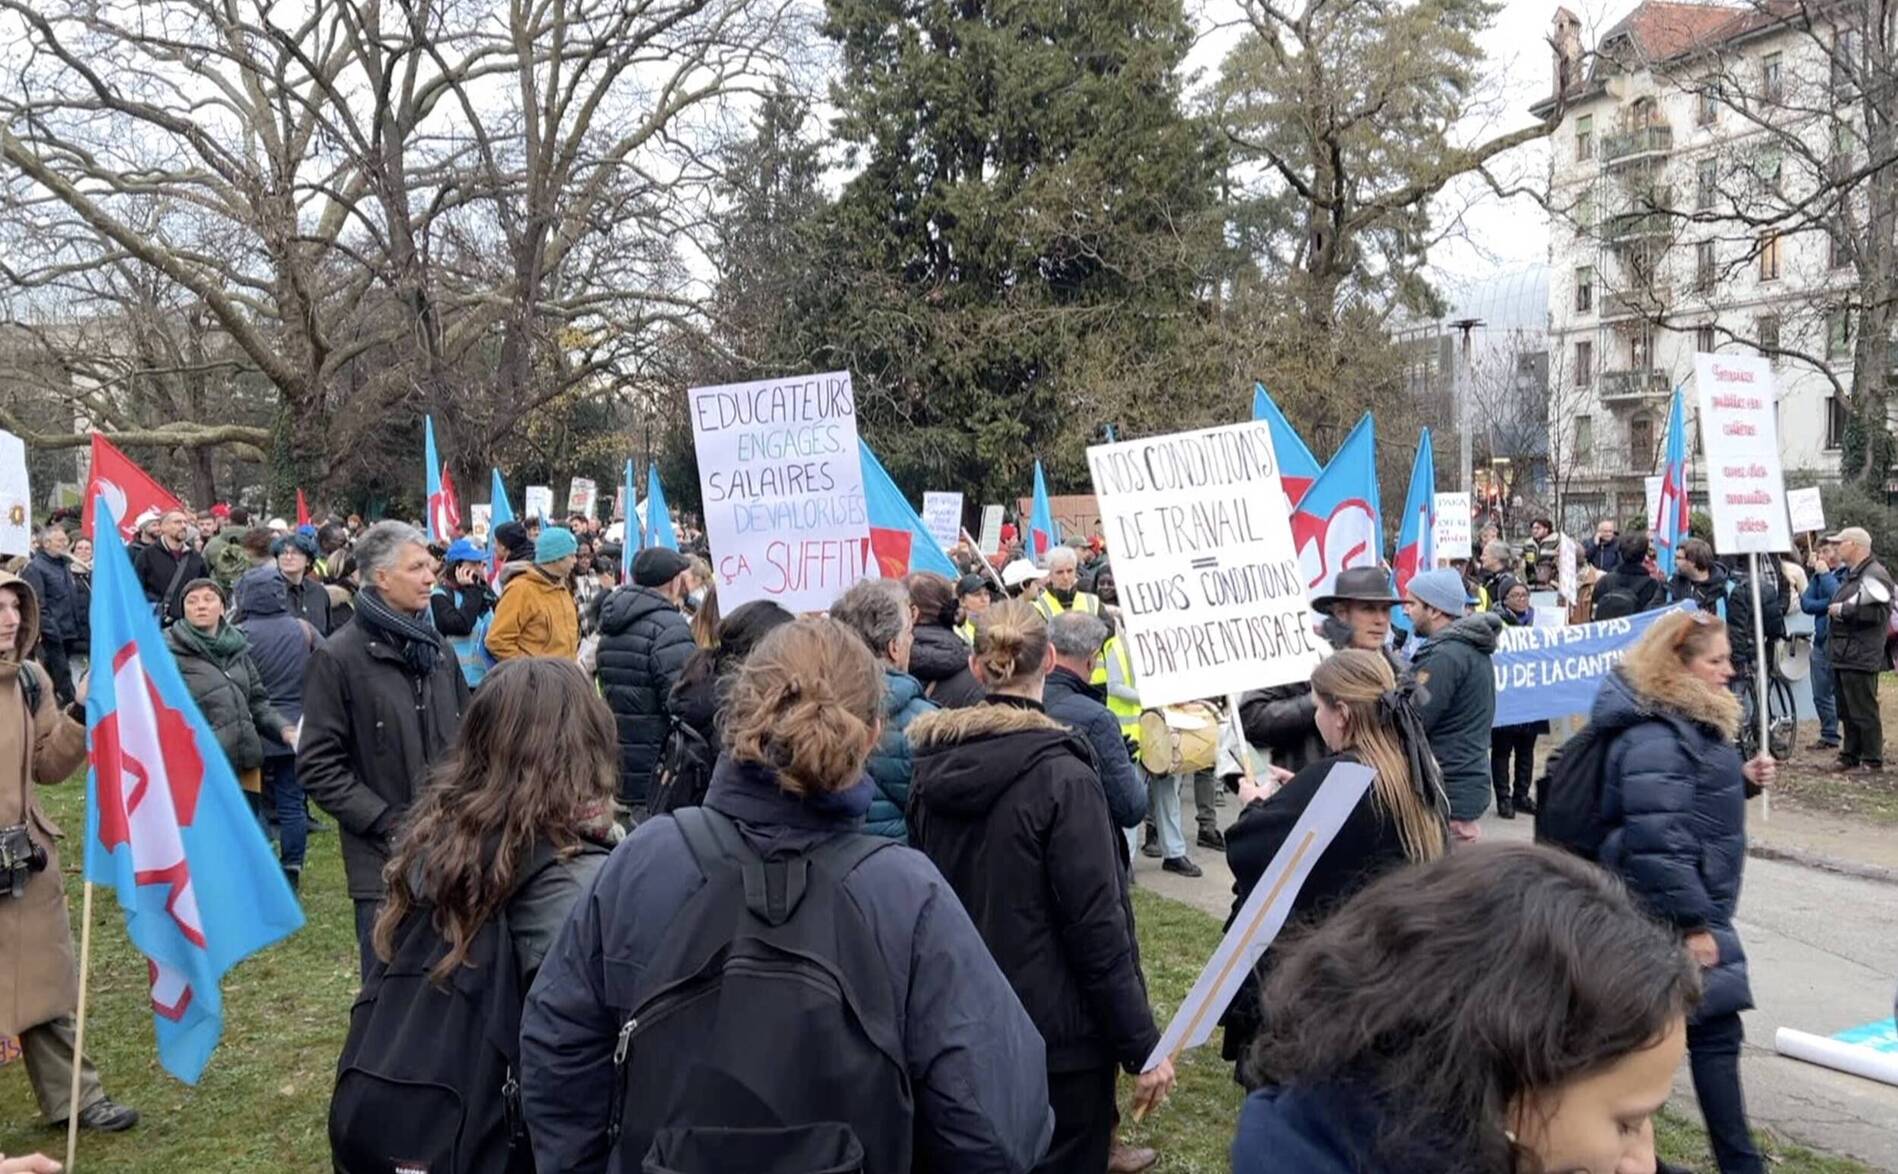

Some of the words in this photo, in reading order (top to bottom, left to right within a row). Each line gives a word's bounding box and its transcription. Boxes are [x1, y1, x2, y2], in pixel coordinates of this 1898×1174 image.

[696, 378, 853, 431] EDUCATEURS
[709, 462, 835, 501] SALAIRES
[1094, 448, 1144, 496] NOS
[1144, 427, 1274, 491] CONDITIONS
[733, 484, 867, 535] DÉVALORISÉS
[1115, 511, 1155, 560] DE
[1155, 497, 1263, 554] TRAVAIL
[1124, 574, 1190, 616] LEURS
[1200, 559, 1302, 607] CONDITIONS
[1133, 610, 1316, 678] D'APPRENTISSAGE
[1494, 625, 1540, 653] AIRE
[1596, 618, 1632, 639] PAS
[1513, 662, 1537, 688] DE
[1541, 660, 1564, 686] LA
